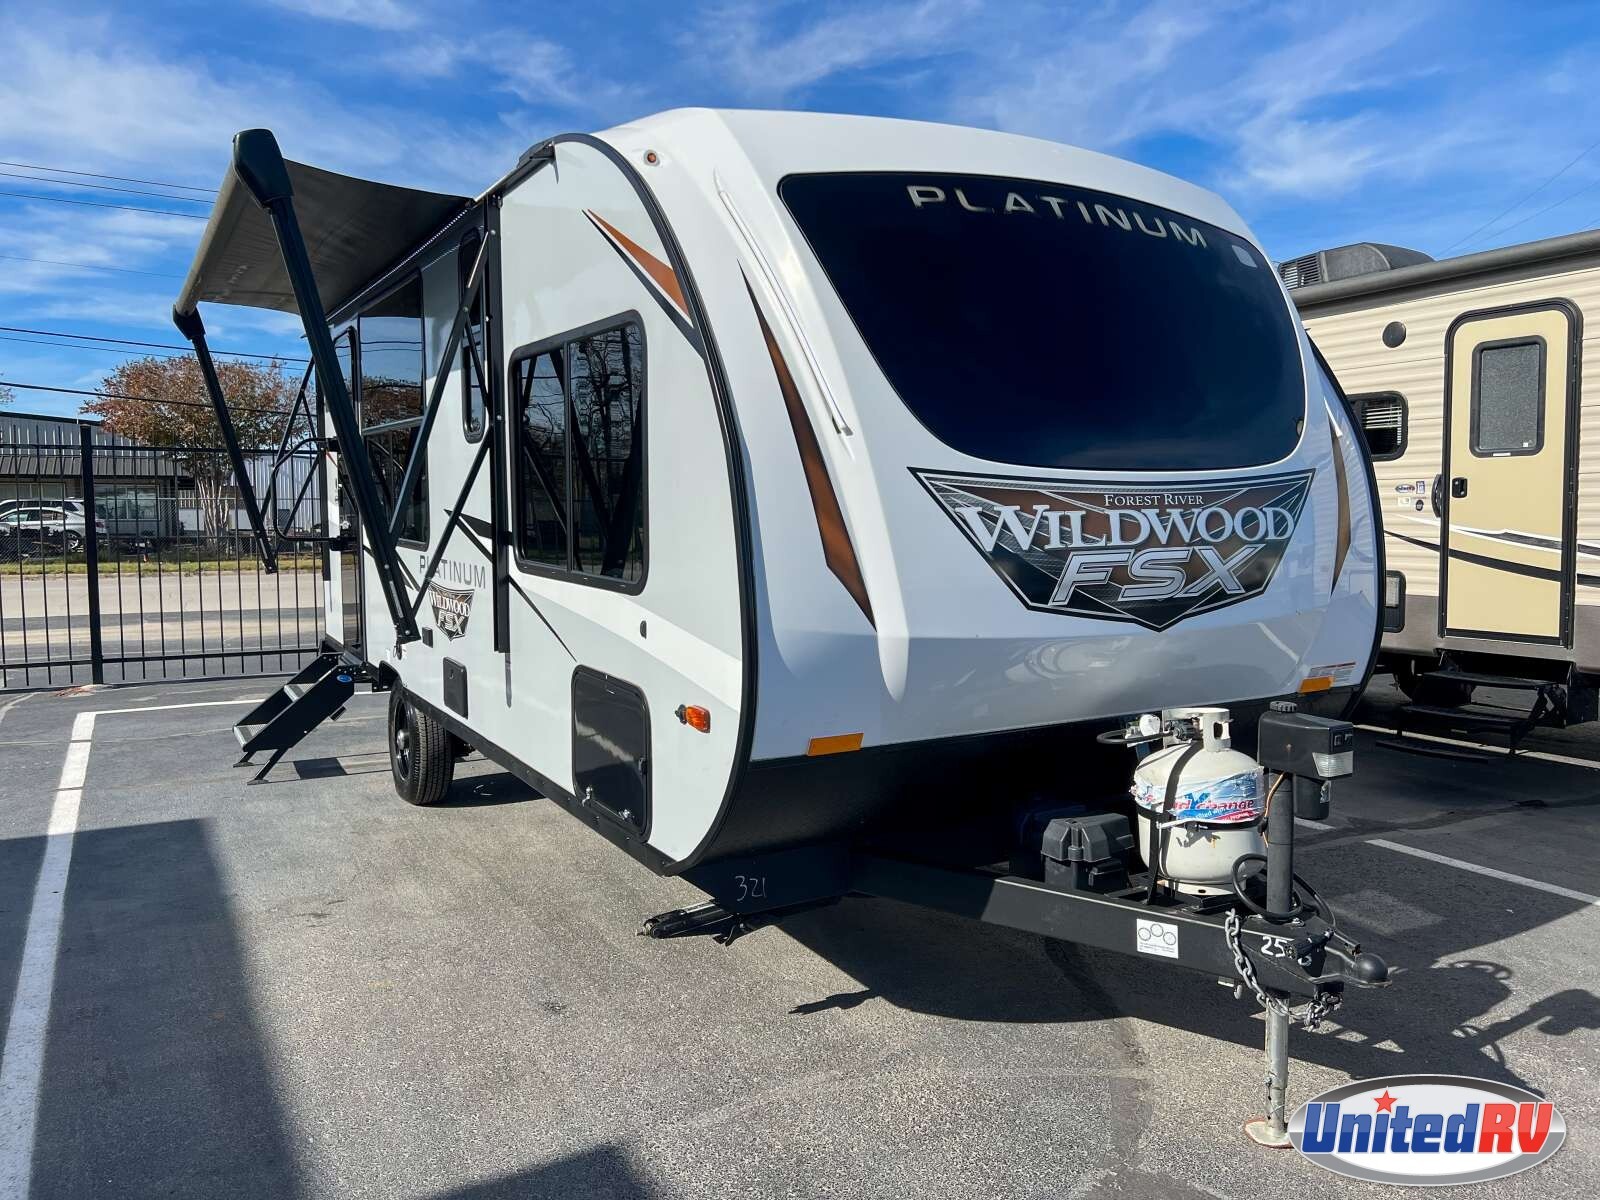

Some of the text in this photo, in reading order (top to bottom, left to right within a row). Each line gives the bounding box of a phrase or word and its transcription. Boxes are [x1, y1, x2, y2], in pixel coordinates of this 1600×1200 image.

[907, 185, 1208, 249] PLATINUM
[1104, 493, 1205, 508] FOREST RIVER
[955, 504, 1296, 553] WILDWOOD
[1048, 544, 1267, 606] FSX
[735, 875, 767, 902] 321
